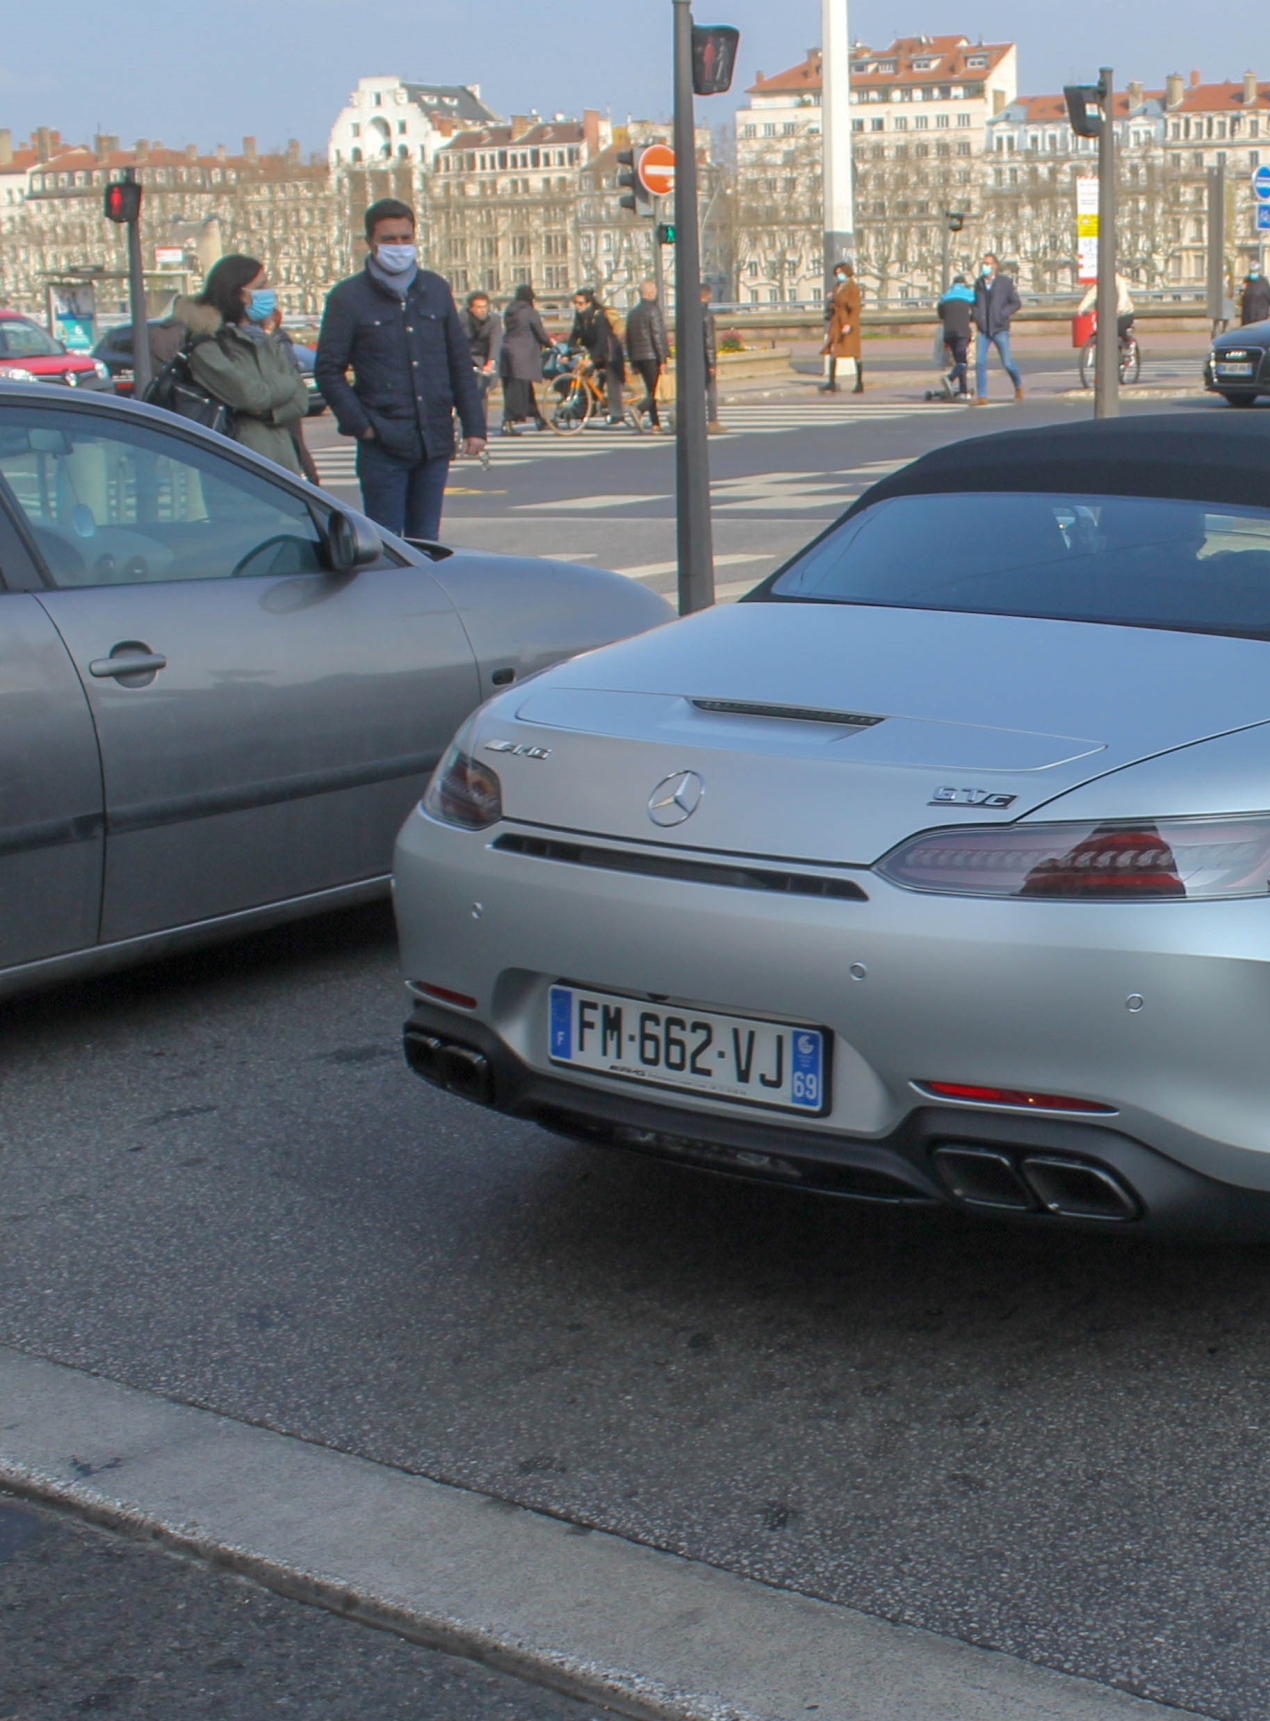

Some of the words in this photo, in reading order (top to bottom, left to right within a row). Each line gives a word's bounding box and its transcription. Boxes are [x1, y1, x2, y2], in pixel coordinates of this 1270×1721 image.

[556, 1031, 565, 1046] F
[577, 999, 784, 1089] FM-662-VJ
[794, 1071, 817, 1100] 69
